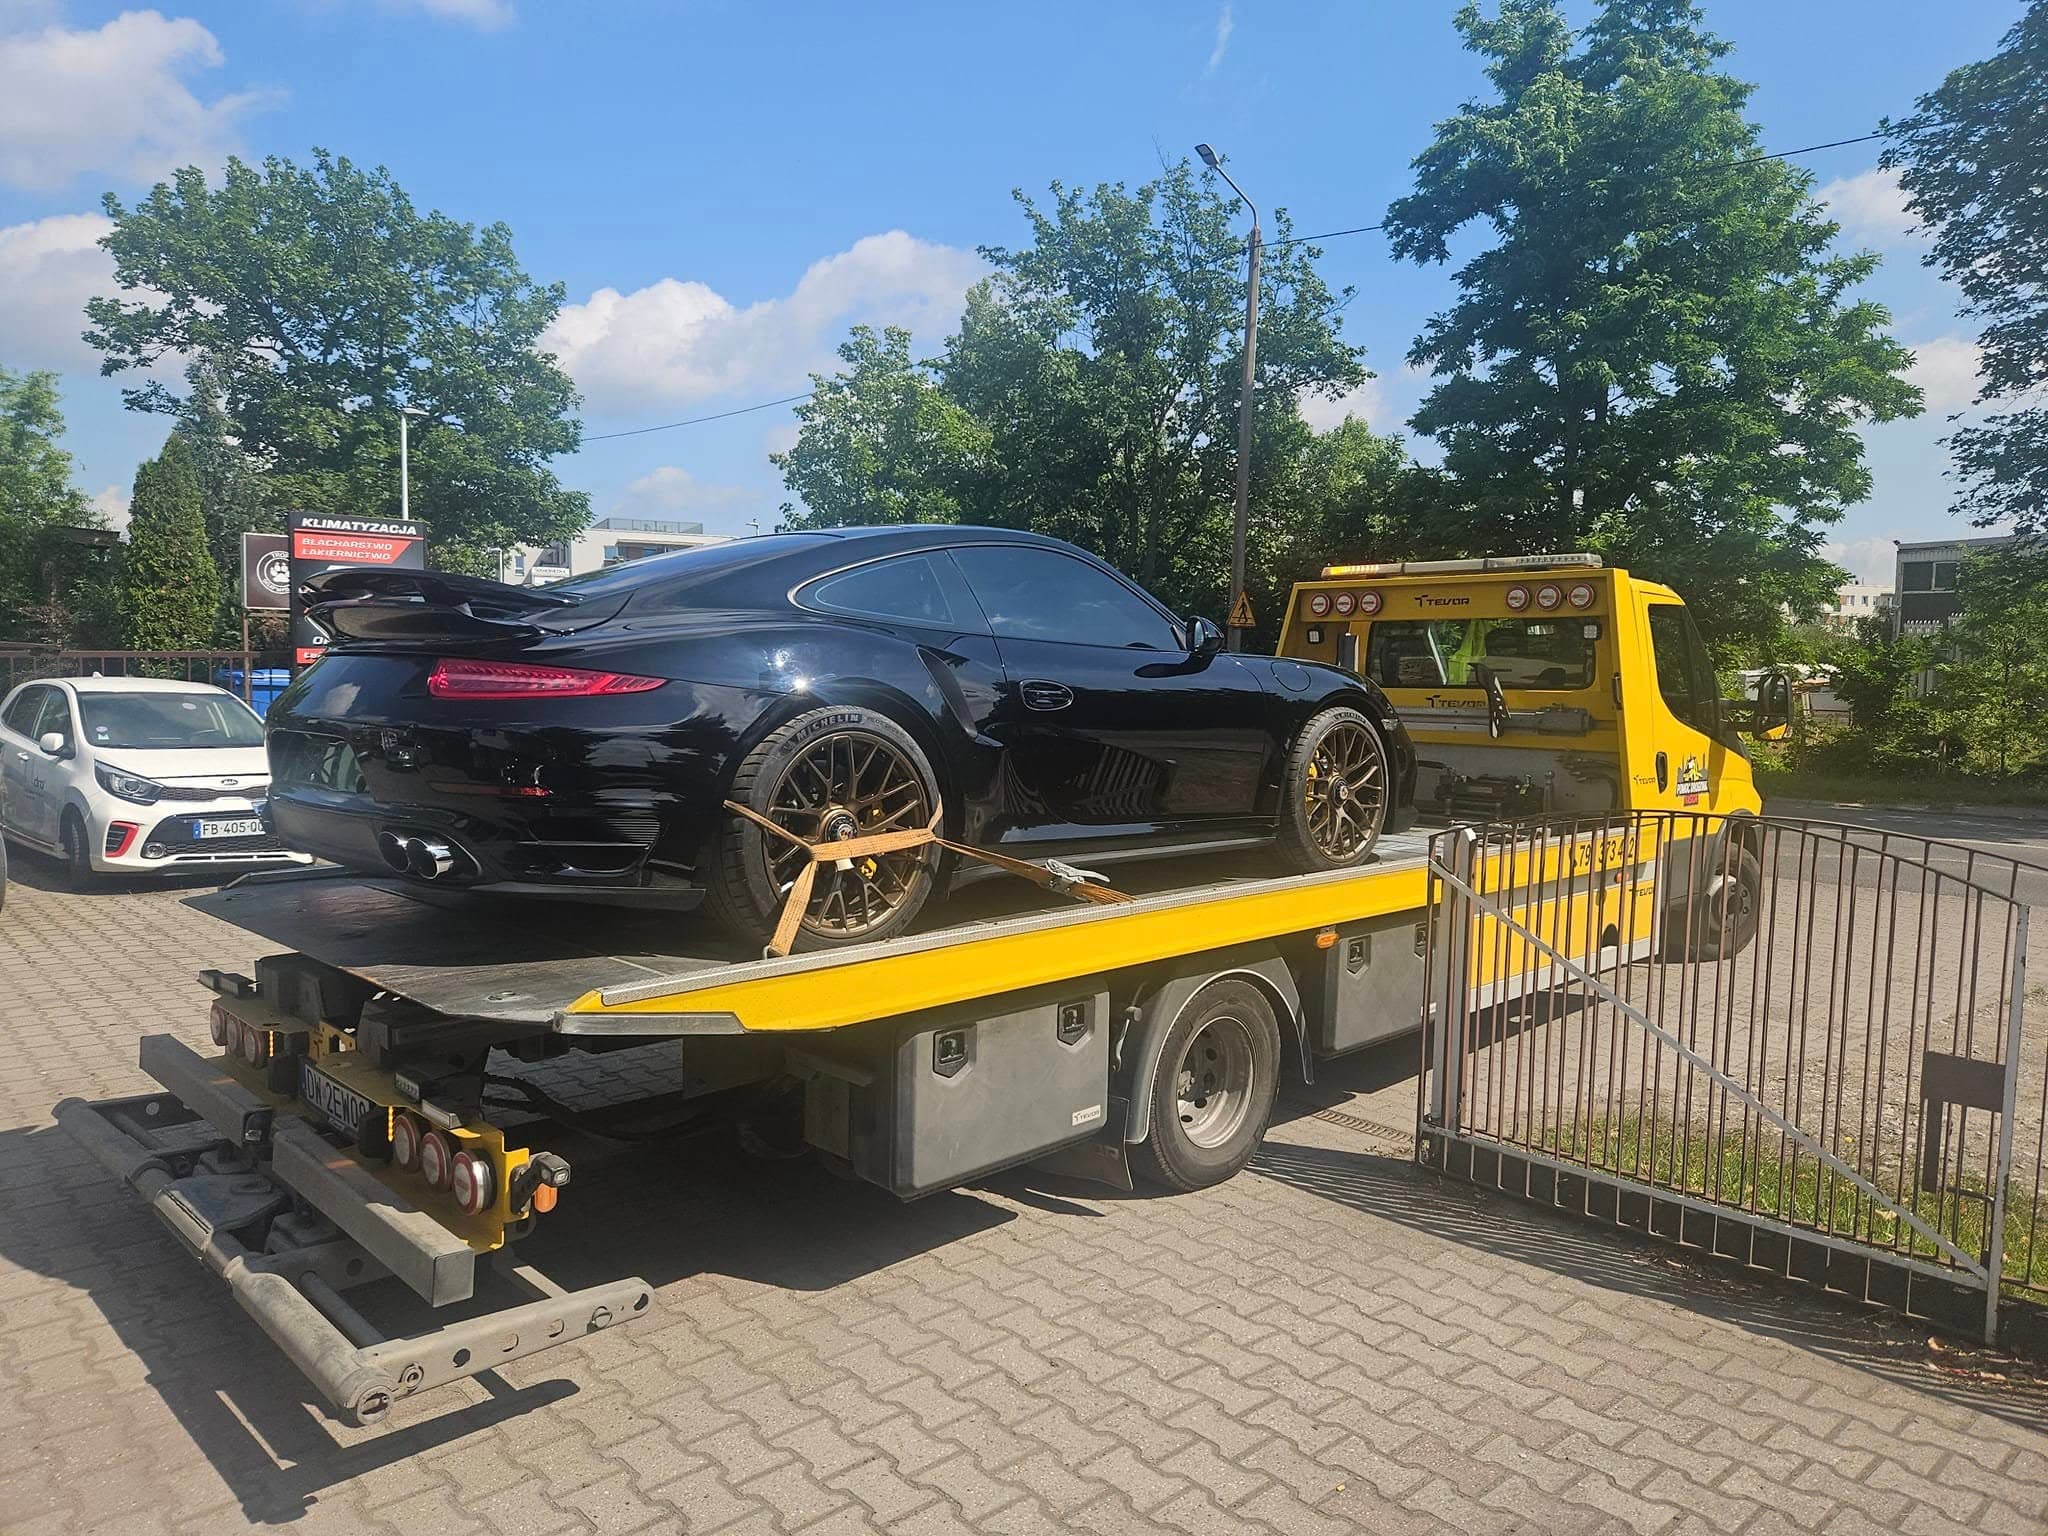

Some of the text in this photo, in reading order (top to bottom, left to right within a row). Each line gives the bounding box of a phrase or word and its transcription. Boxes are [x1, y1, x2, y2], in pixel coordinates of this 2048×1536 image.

[302, 518, 417, 535] KLIMATYZACJA
[302, 537, 393, 551] BLACHARSTWO
[302, 548, 391, 560] LAKIERNICTWO
[798, 713, 860, 740] MICHELIN
[306, 1068, 322, 1105] DW
